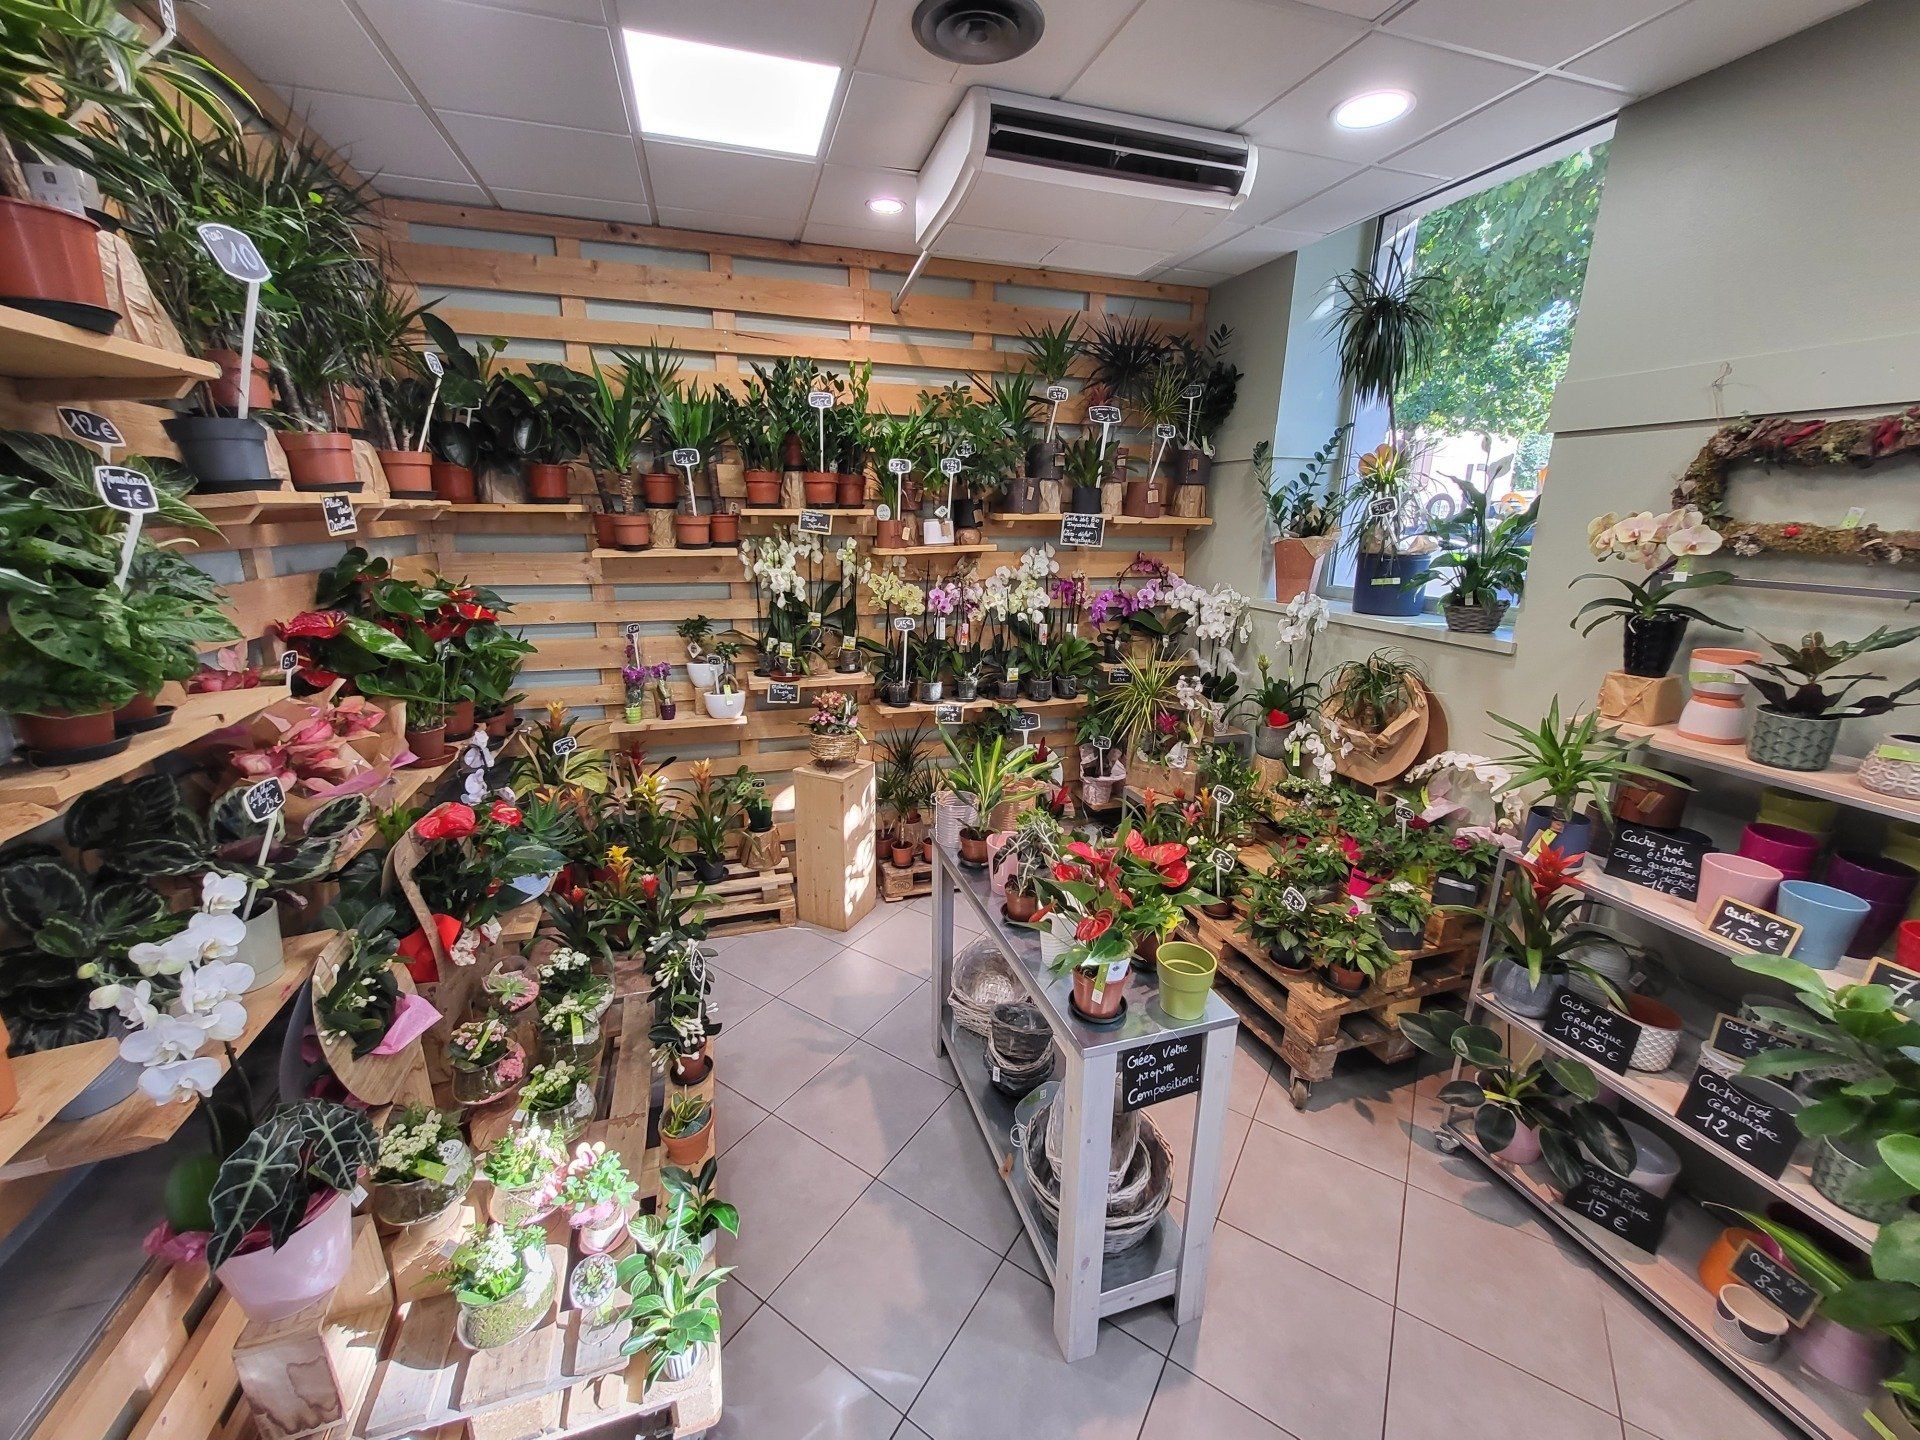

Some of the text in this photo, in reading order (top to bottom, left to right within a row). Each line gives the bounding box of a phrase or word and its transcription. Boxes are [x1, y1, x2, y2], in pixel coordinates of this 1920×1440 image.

[1621, 830, 1685, 856] Cache pot
[1646, 848, 1693, 869] étanche
[1724, 906, 1761, 928] Cache
[1560, 994, 1591, 1015] Cache
[1725, 1021, 1760, 1039] Cache
[1127, 1051, 1157, 1069] Créez
[1136, 1062, 1175, 1086] propre
[1698, 1074, 1741, 1105] Cache
